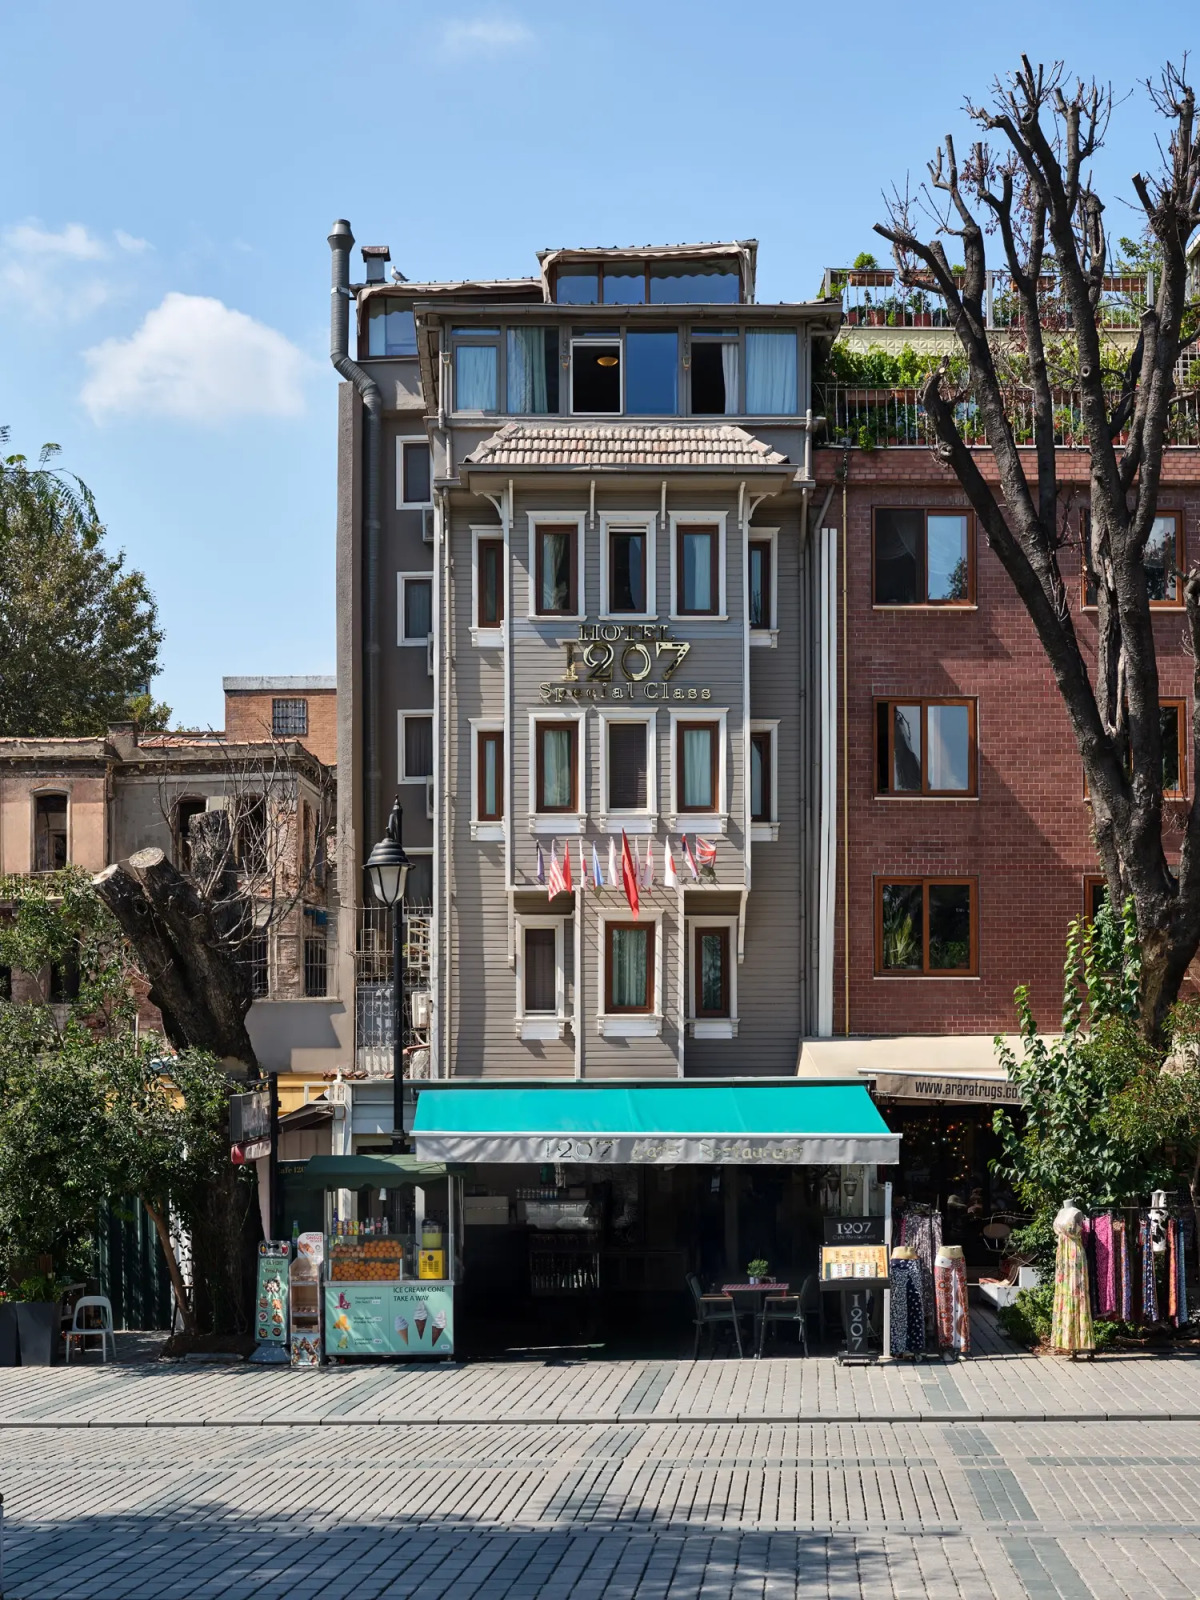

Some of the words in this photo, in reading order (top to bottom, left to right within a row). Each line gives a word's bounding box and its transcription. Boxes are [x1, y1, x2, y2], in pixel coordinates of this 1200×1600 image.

[578, 624, 675, 641] HOTEL
[539, 682, 634, 702] Special
[643, 682, 712, 700] Class
[836, 1222, 871, 1235] 1207
